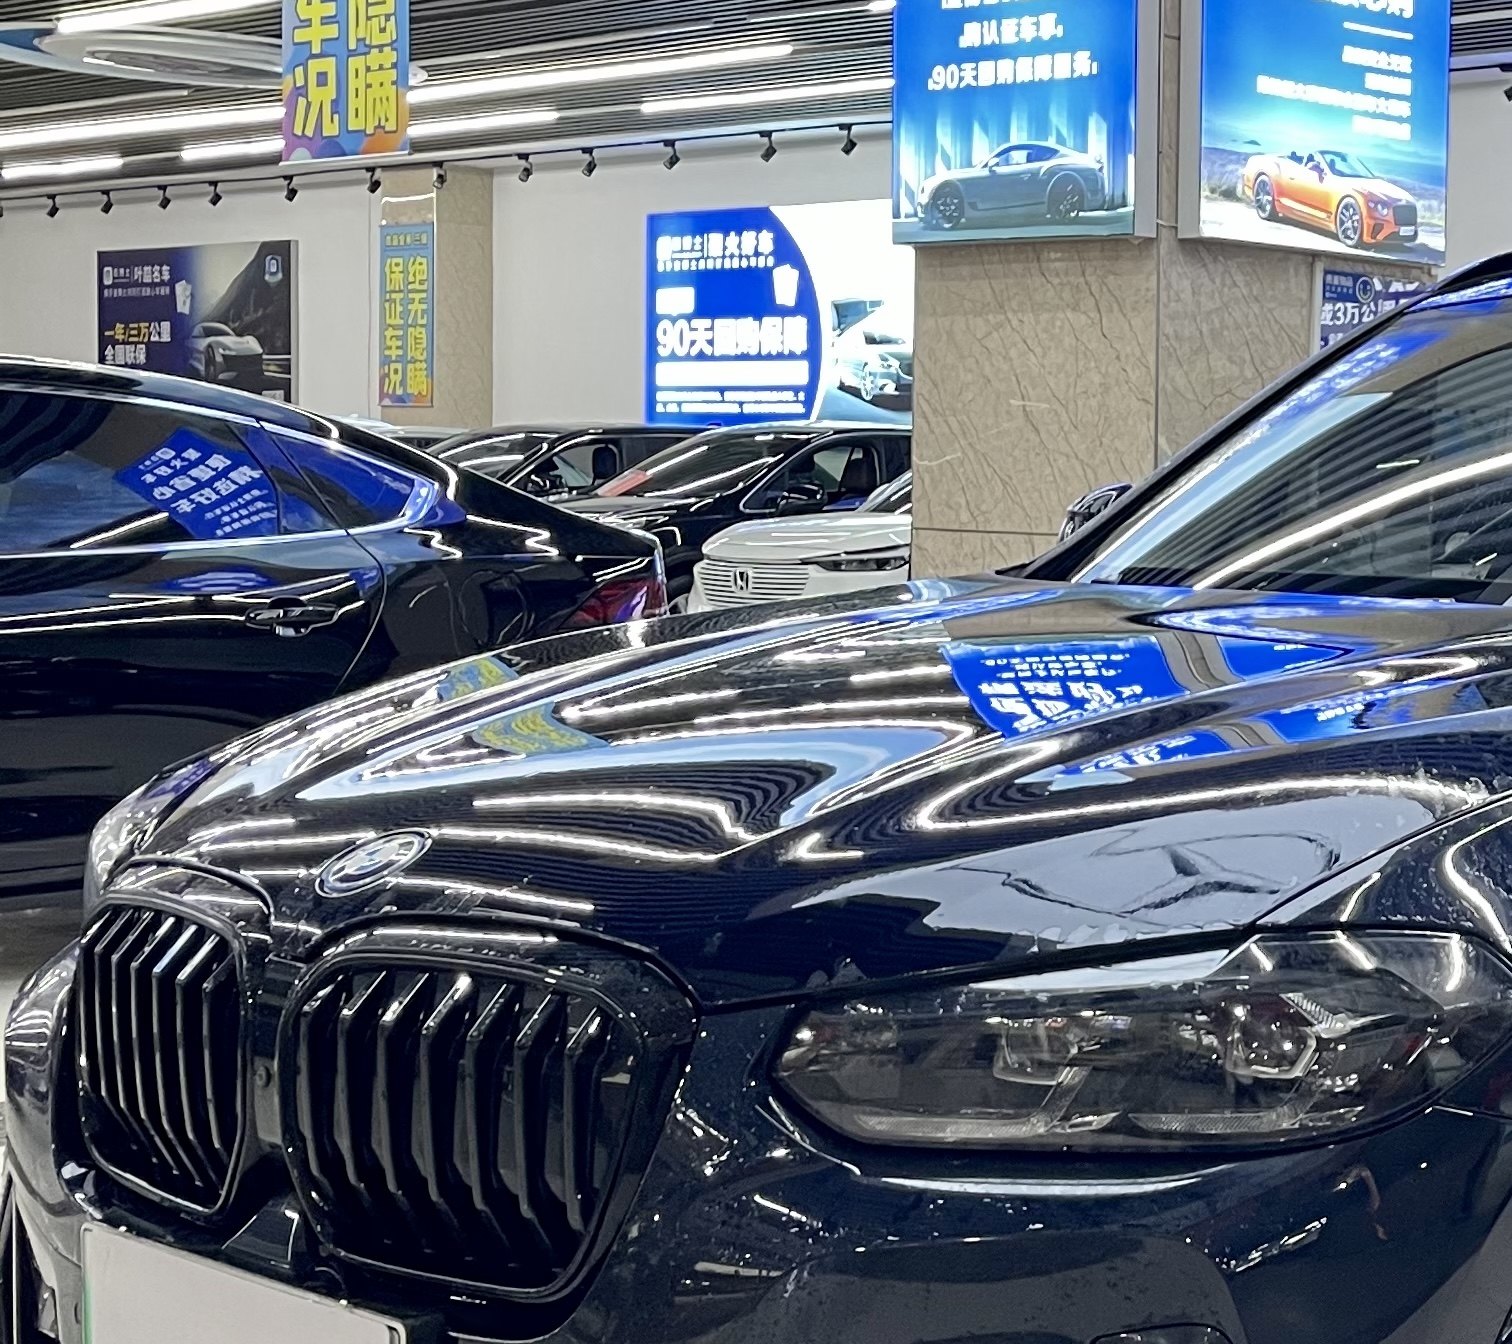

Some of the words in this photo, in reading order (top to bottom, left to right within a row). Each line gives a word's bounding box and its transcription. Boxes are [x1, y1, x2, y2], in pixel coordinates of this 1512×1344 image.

[383, 257, 405, 396] 保证车况
[406, 254, 429, 396] 绝无隐瞒
[656, 314, 808, 357] 90天回购保障
